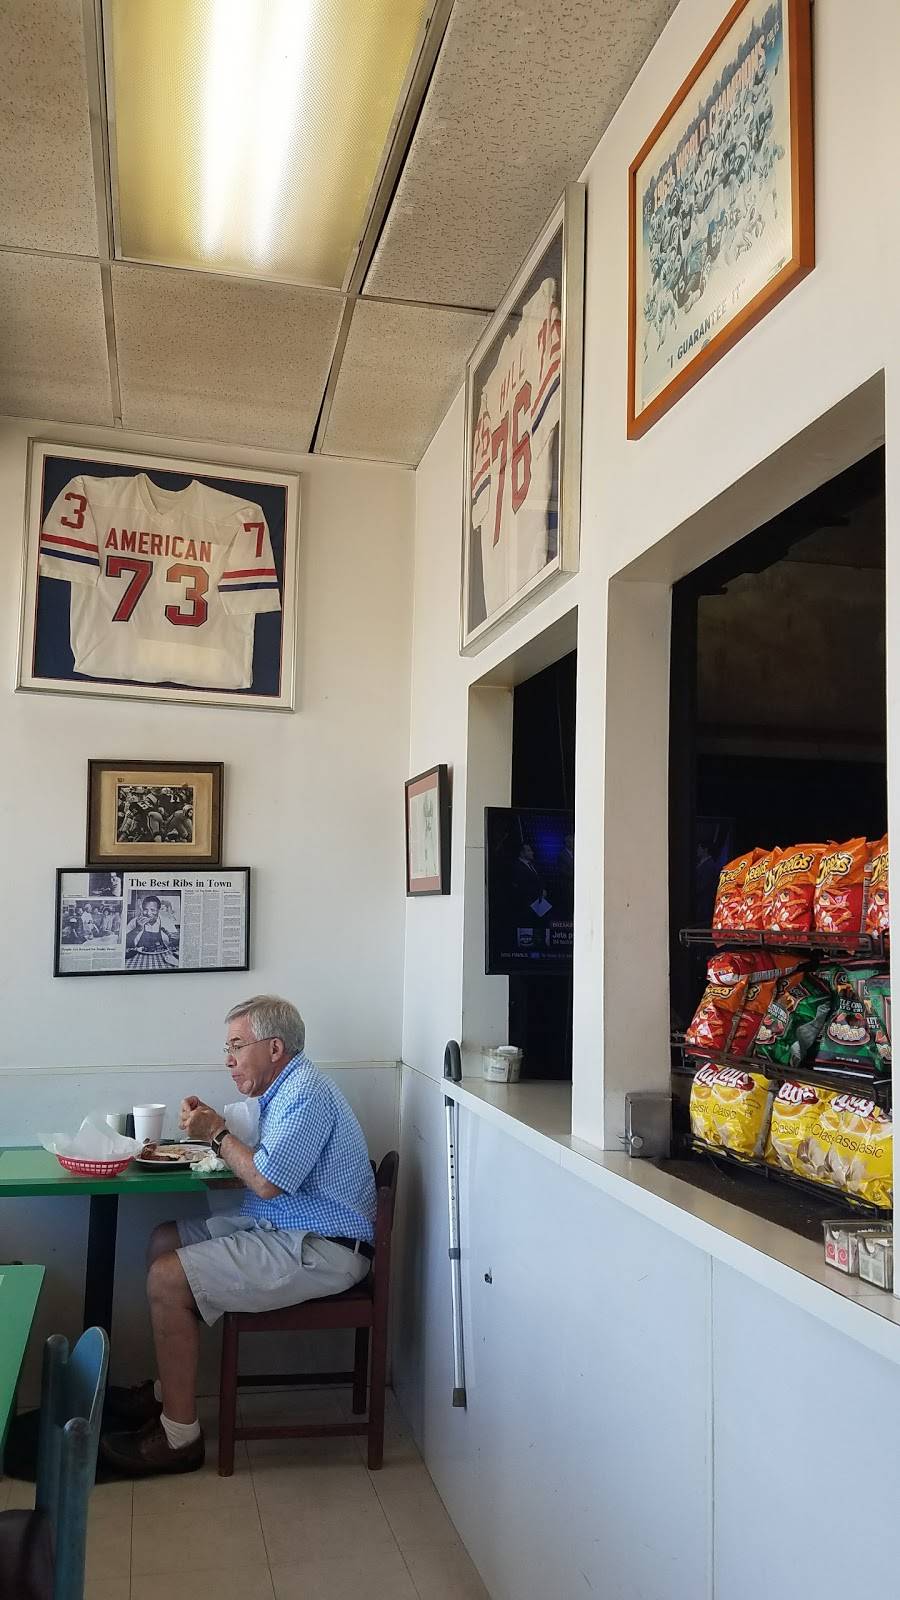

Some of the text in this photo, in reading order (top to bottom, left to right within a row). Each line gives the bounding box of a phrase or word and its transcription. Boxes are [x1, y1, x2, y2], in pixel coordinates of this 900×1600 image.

[677, 303, 726, 360] GUARANTEE
[500, 347, 526, 413] HILL
[491, 380, 532, 548] 76
[61, 491, 88, 530] 3
[105, 527, 212, 563] AMERICAN
[243, 521, 265, 558] 7
[105, 554, 210, 628] 73
[128, 878, 232, 888] The Best Ribs in Town
[713, 1103, 737, 1120] Classic
[771, 1120, 800, 1137] Classic
